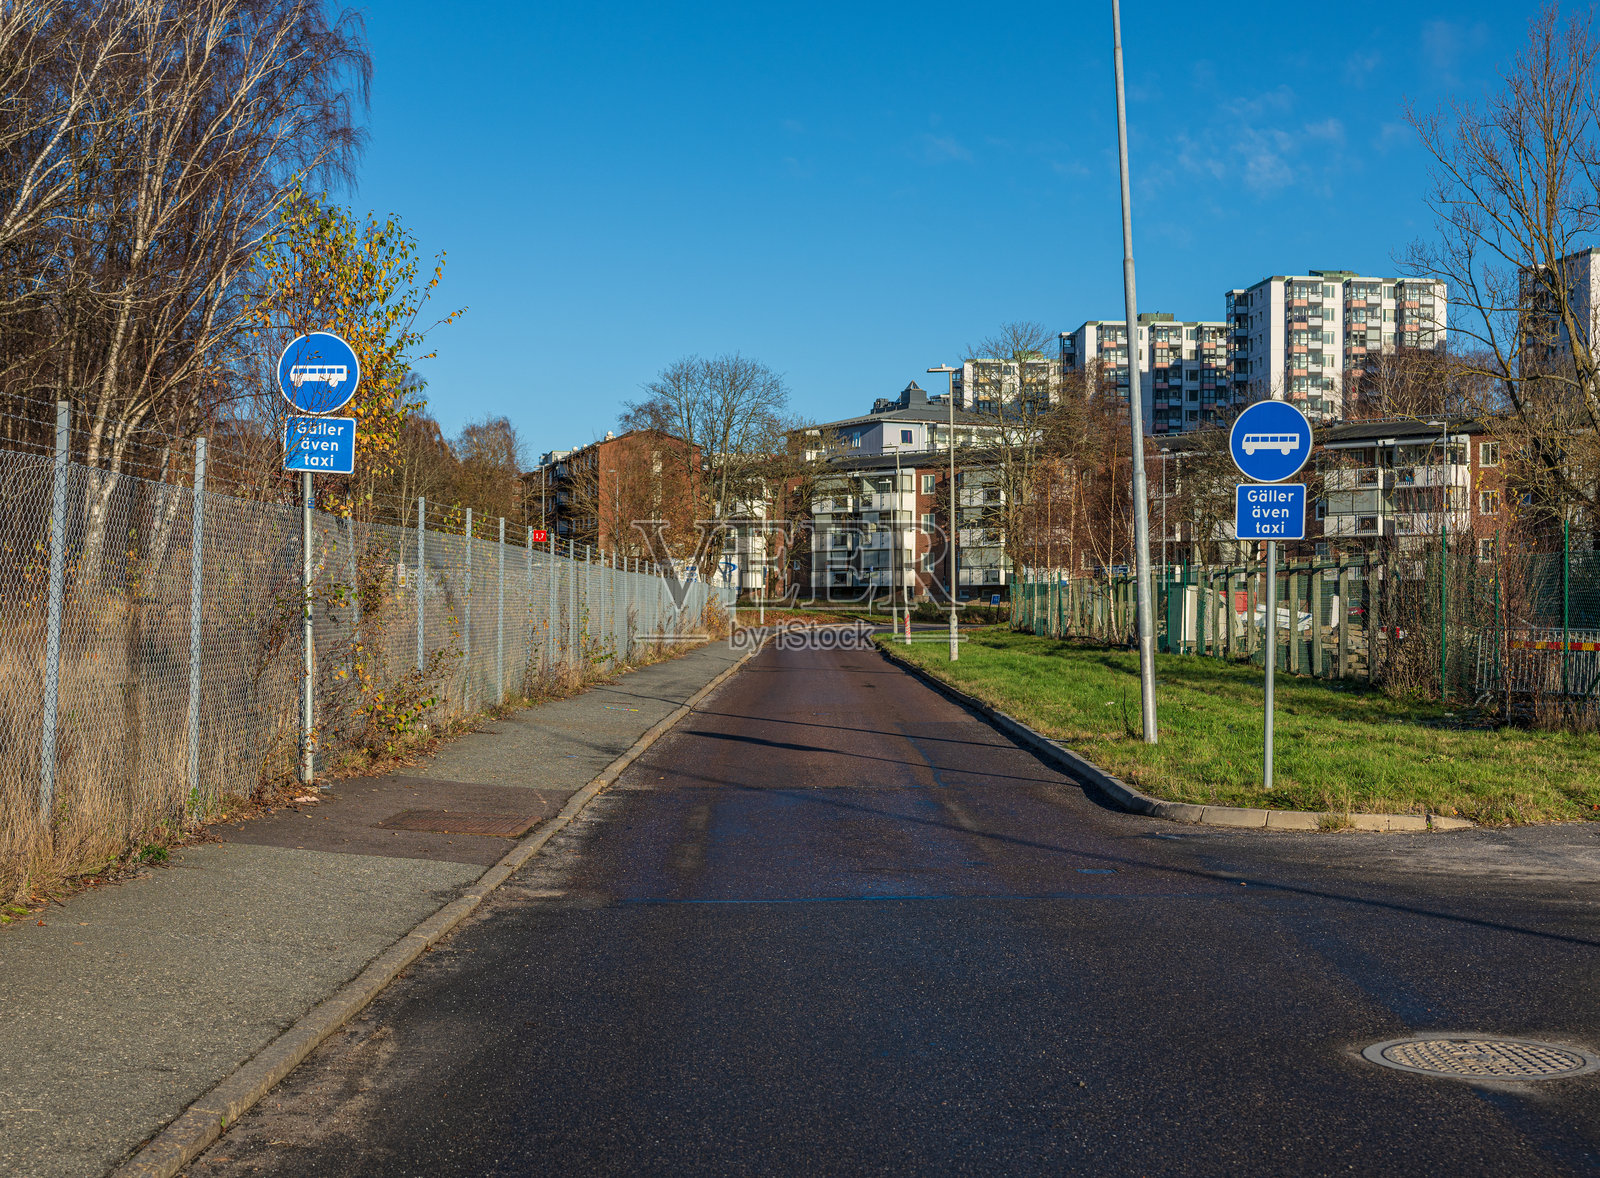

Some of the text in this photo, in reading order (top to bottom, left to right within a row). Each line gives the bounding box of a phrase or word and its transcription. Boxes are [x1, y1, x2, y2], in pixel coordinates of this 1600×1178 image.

[297, 421, 344, 436] Gäller
[301, 437, 339, 451] även
[304, 453, 334, 467] taxi
[1247, 490, 1294, 502] Gäller
[1251, 505, 1289, 518] även
[1255, 521, 1285, 534] taxi
